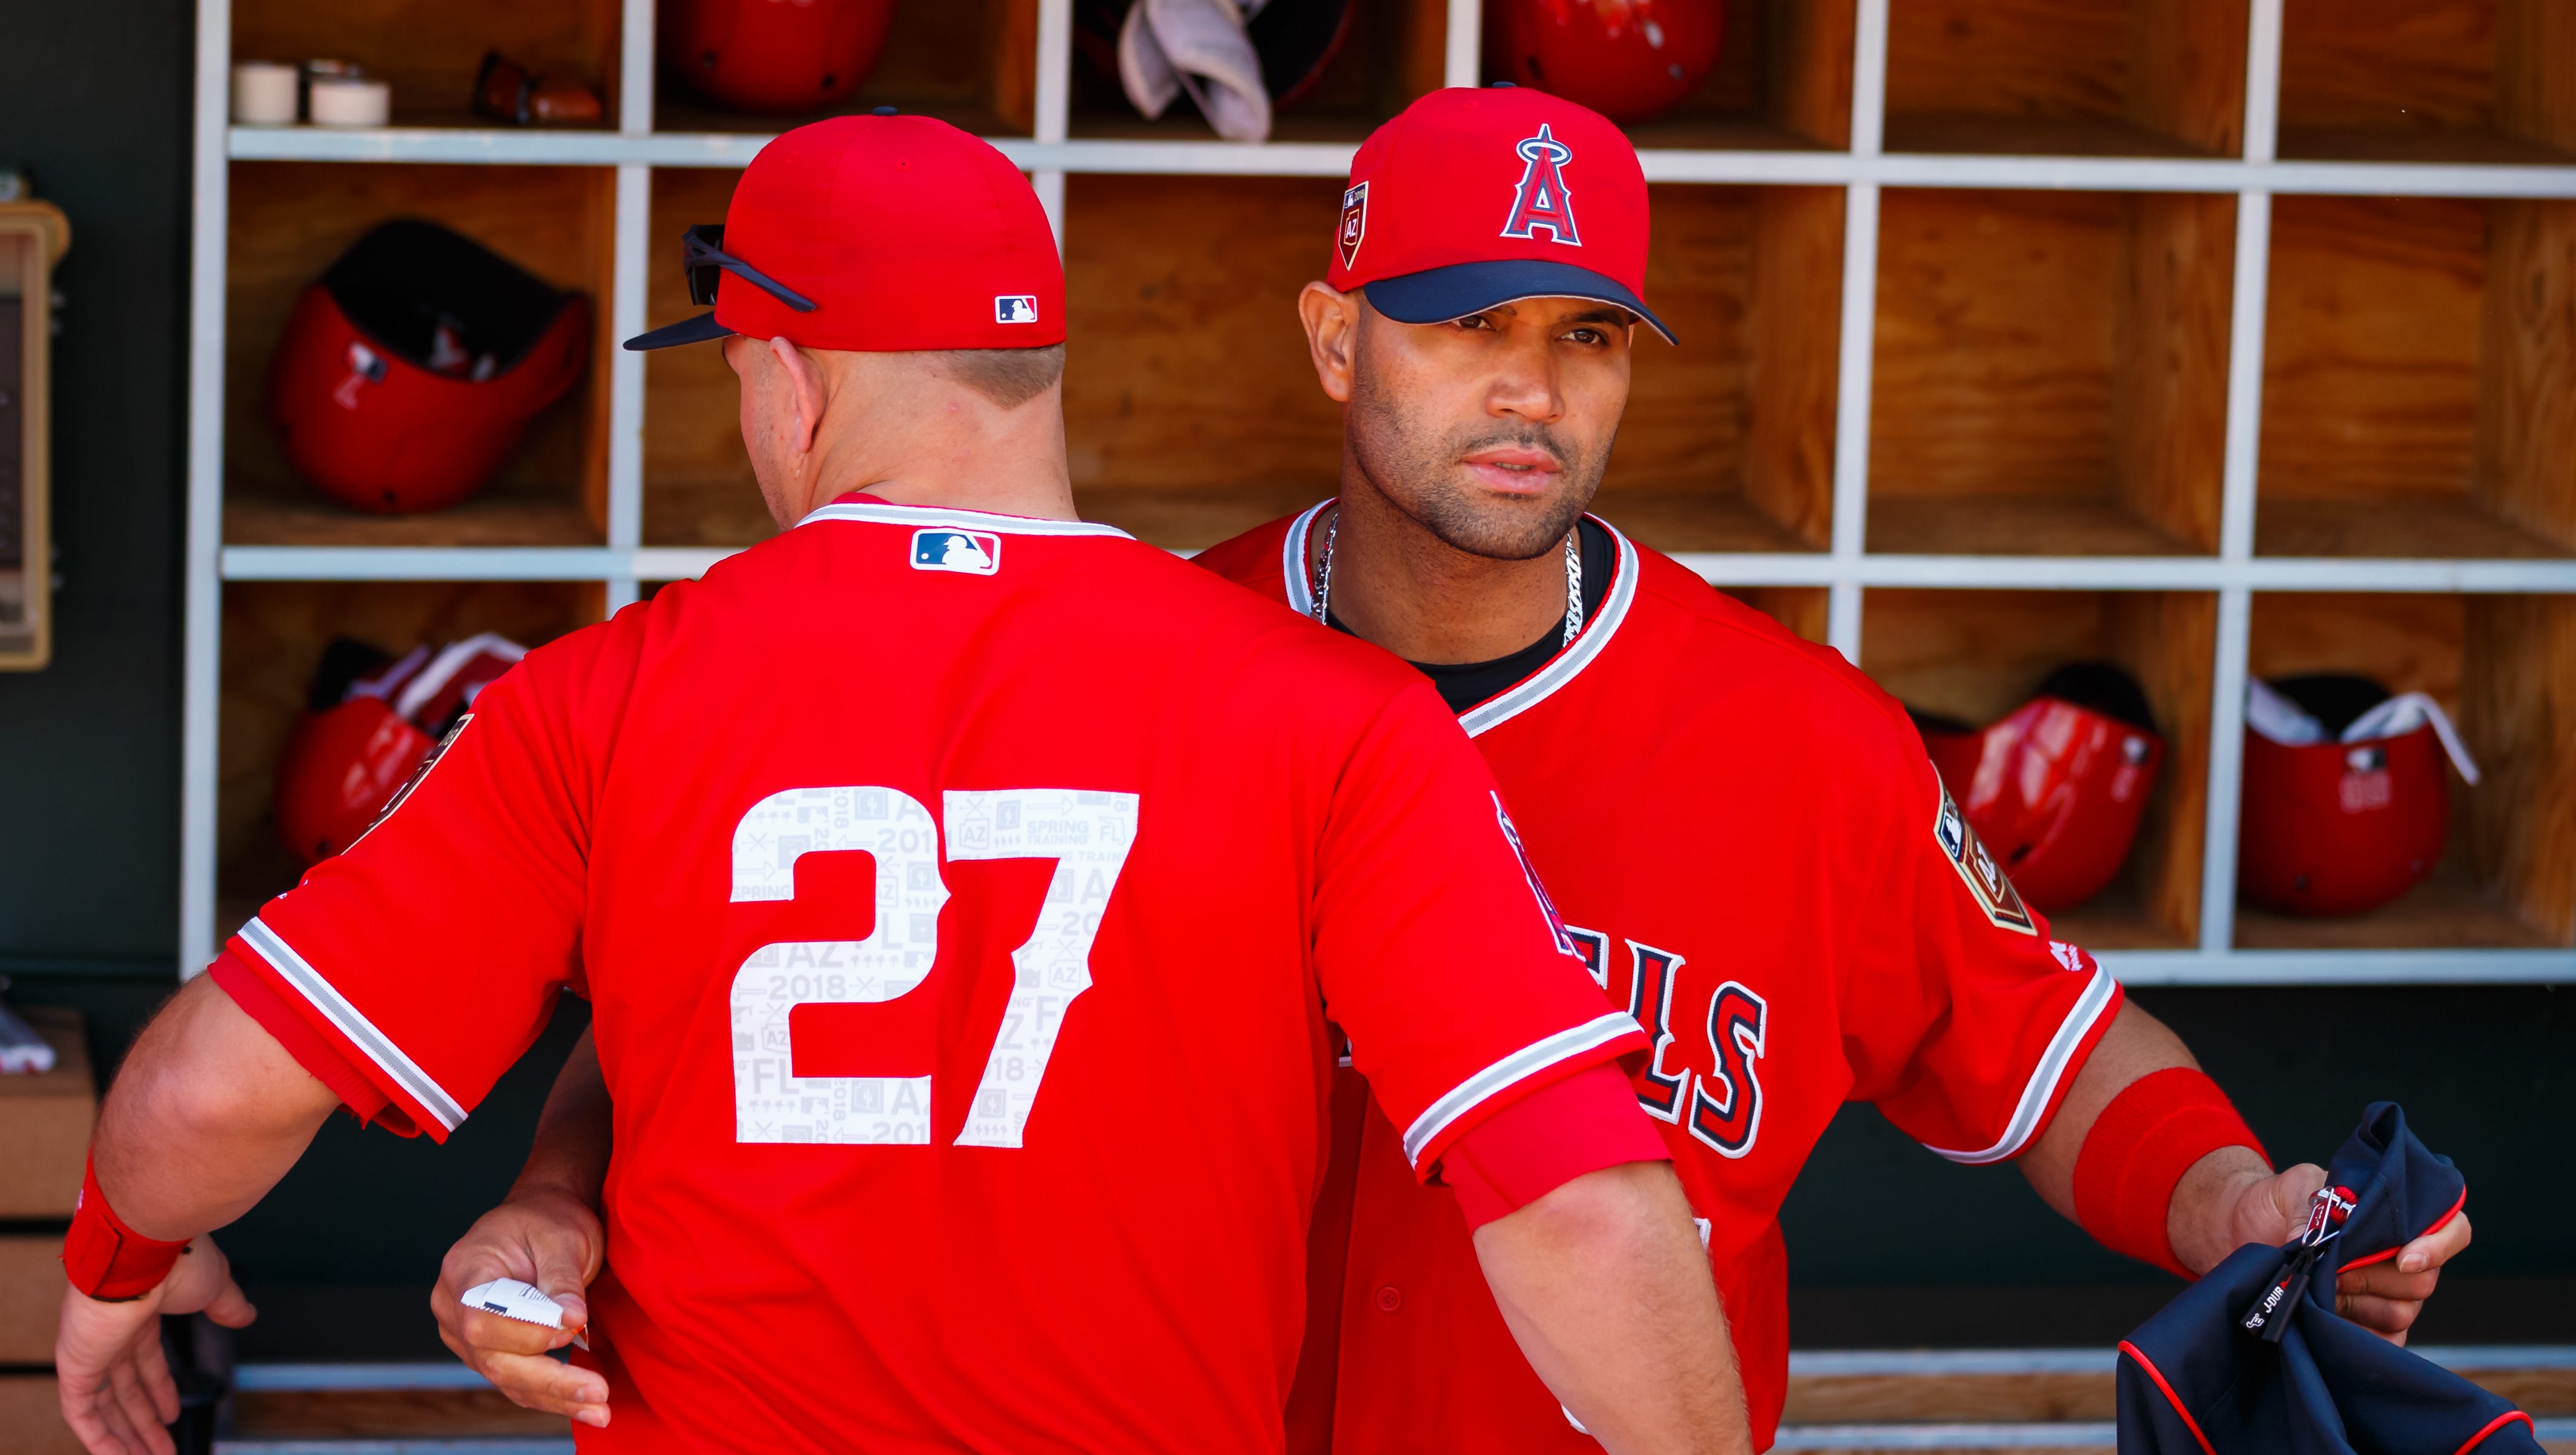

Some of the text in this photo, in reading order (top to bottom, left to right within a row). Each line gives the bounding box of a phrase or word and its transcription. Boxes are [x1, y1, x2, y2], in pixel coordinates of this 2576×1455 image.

[1499, 124, 1582, 246] A
[1346, 219, 1357, 239] AZ
[963, 827, 986, 842] AZ
[1027, 820, 1088, 834] SPRING
[1099, 825, 1121, 841] FL
[1027, 835, 1088, 845] TRAINING
[733, 885, 791, 899] SPRING
[730, 786, 1140, 1148] 27
[1052, 967, 1077, 983] AZ
[768, 974, 846, 1000] 2018
[753, 1058, 800, 1094] FL
